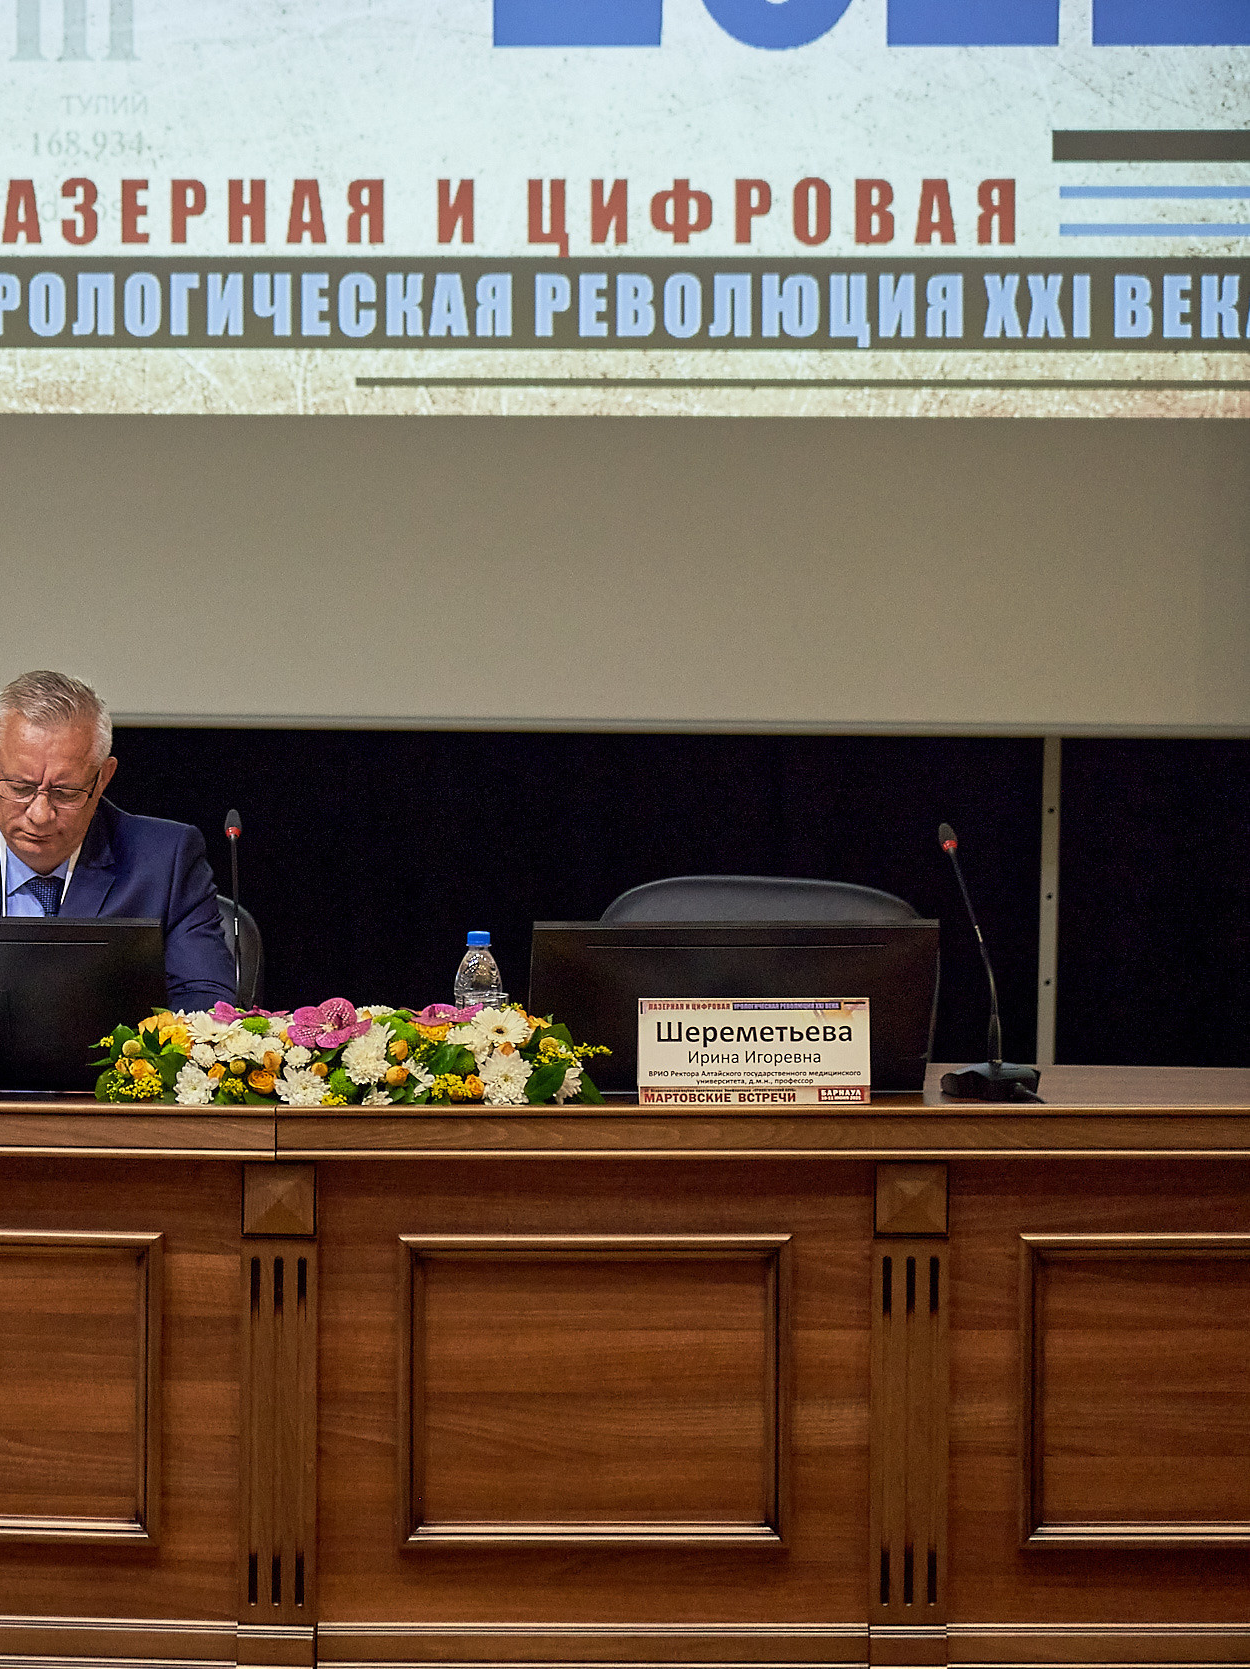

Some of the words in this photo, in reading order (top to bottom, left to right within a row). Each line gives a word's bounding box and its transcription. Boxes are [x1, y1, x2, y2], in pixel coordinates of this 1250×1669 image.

[438, 180, 474, 244] И
[528, 178, 1015, 257] ЦИФРОВАЯ
[535, 274, 963, 347] РЕВОЛЮЦИЯ
[1114, 274, 1250, 338] ВЕК
[656, 1021, 853, 1047] Шереметьева
[688, 1051, 739, 1066] Ирина
[745, 1051, 821, 1066] Игоревна
[670, 1070, 700, 1078] Ректора
[644, 1093, 732, 1103] МАРТОВСКИЕ
[738, 1092, 796, 1103] ВСТРЕЧИ
